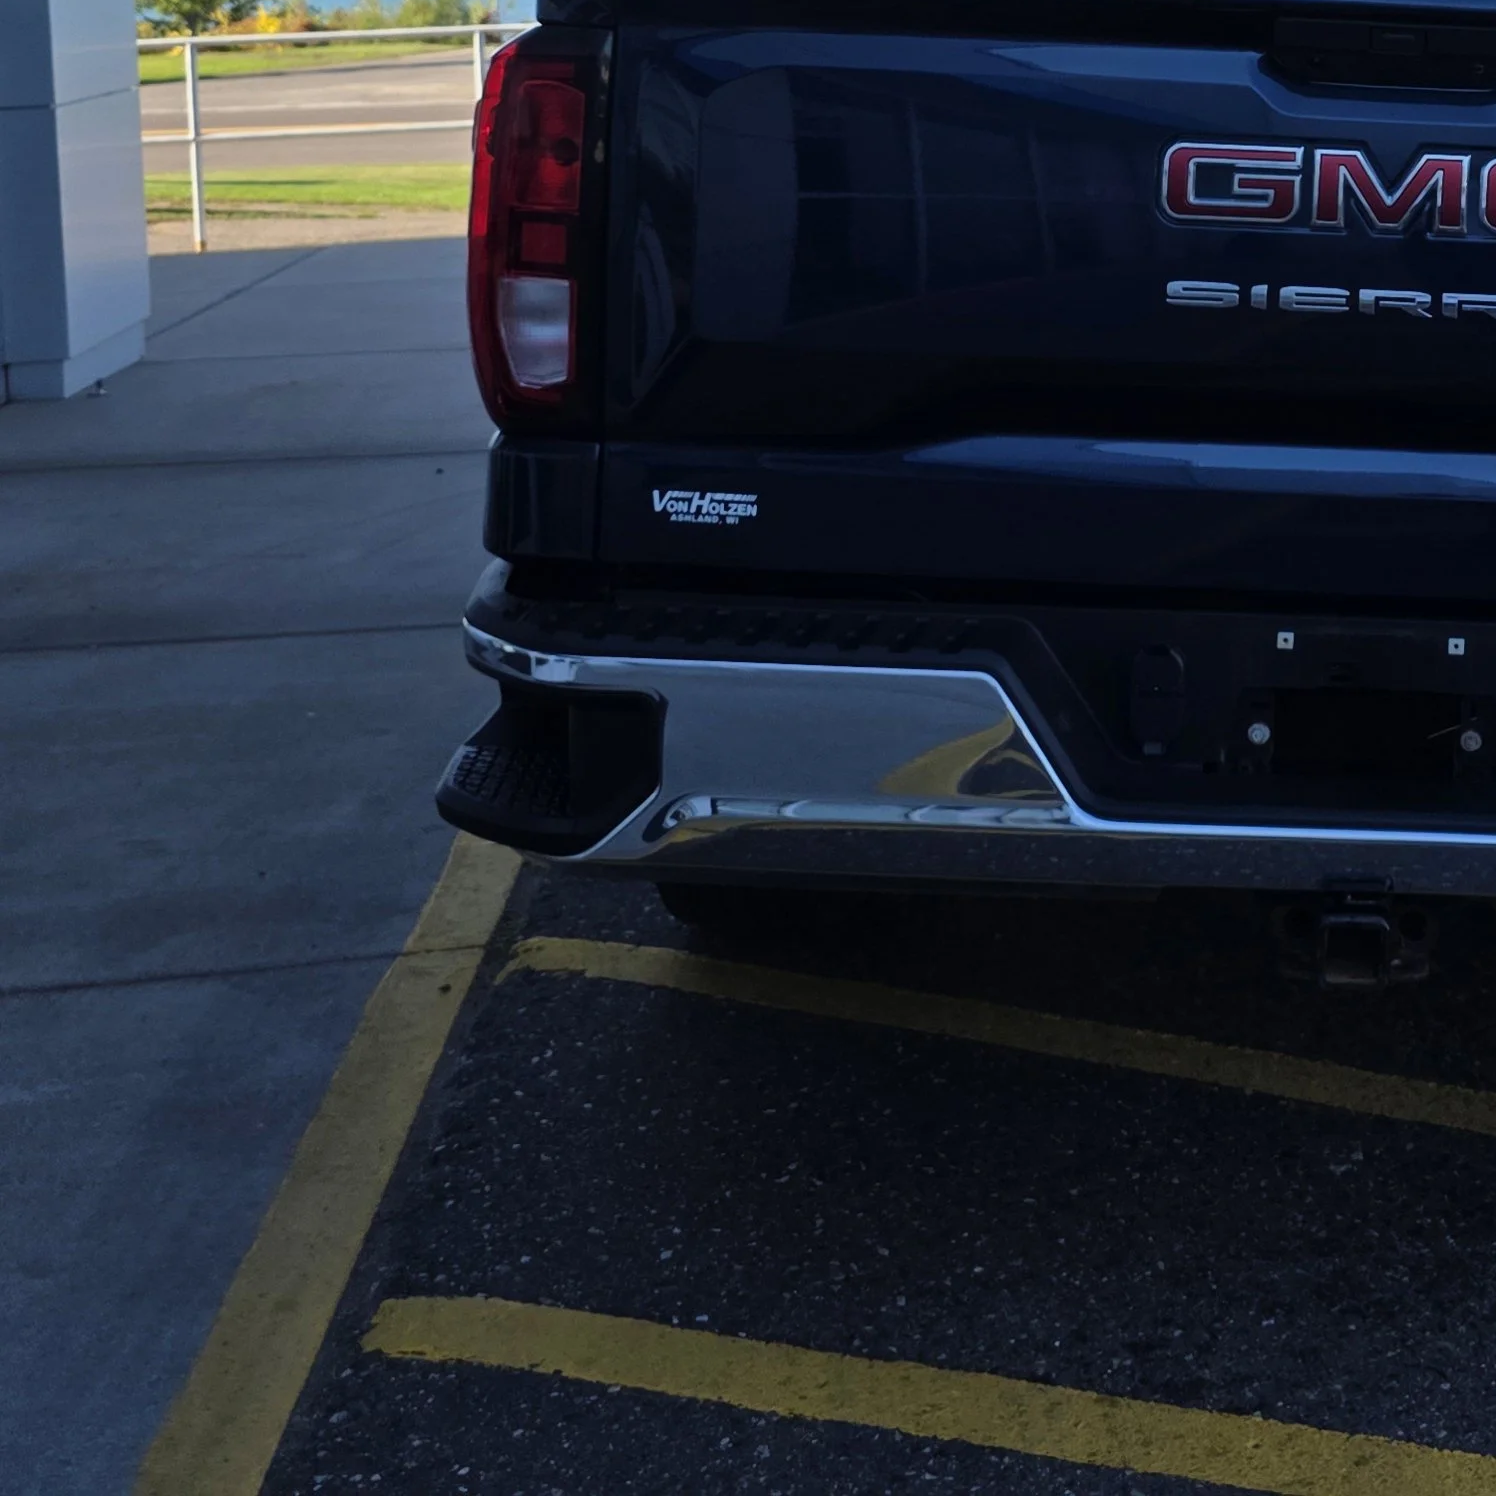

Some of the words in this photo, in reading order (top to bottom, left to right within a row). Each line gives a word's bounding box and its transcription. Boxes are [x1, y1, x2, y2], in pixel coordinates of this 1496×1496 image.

[652, 489, 691, 513] VON
[690, 491, 758, 517] HOLZEN
[725, 516, 739, 524] WI
